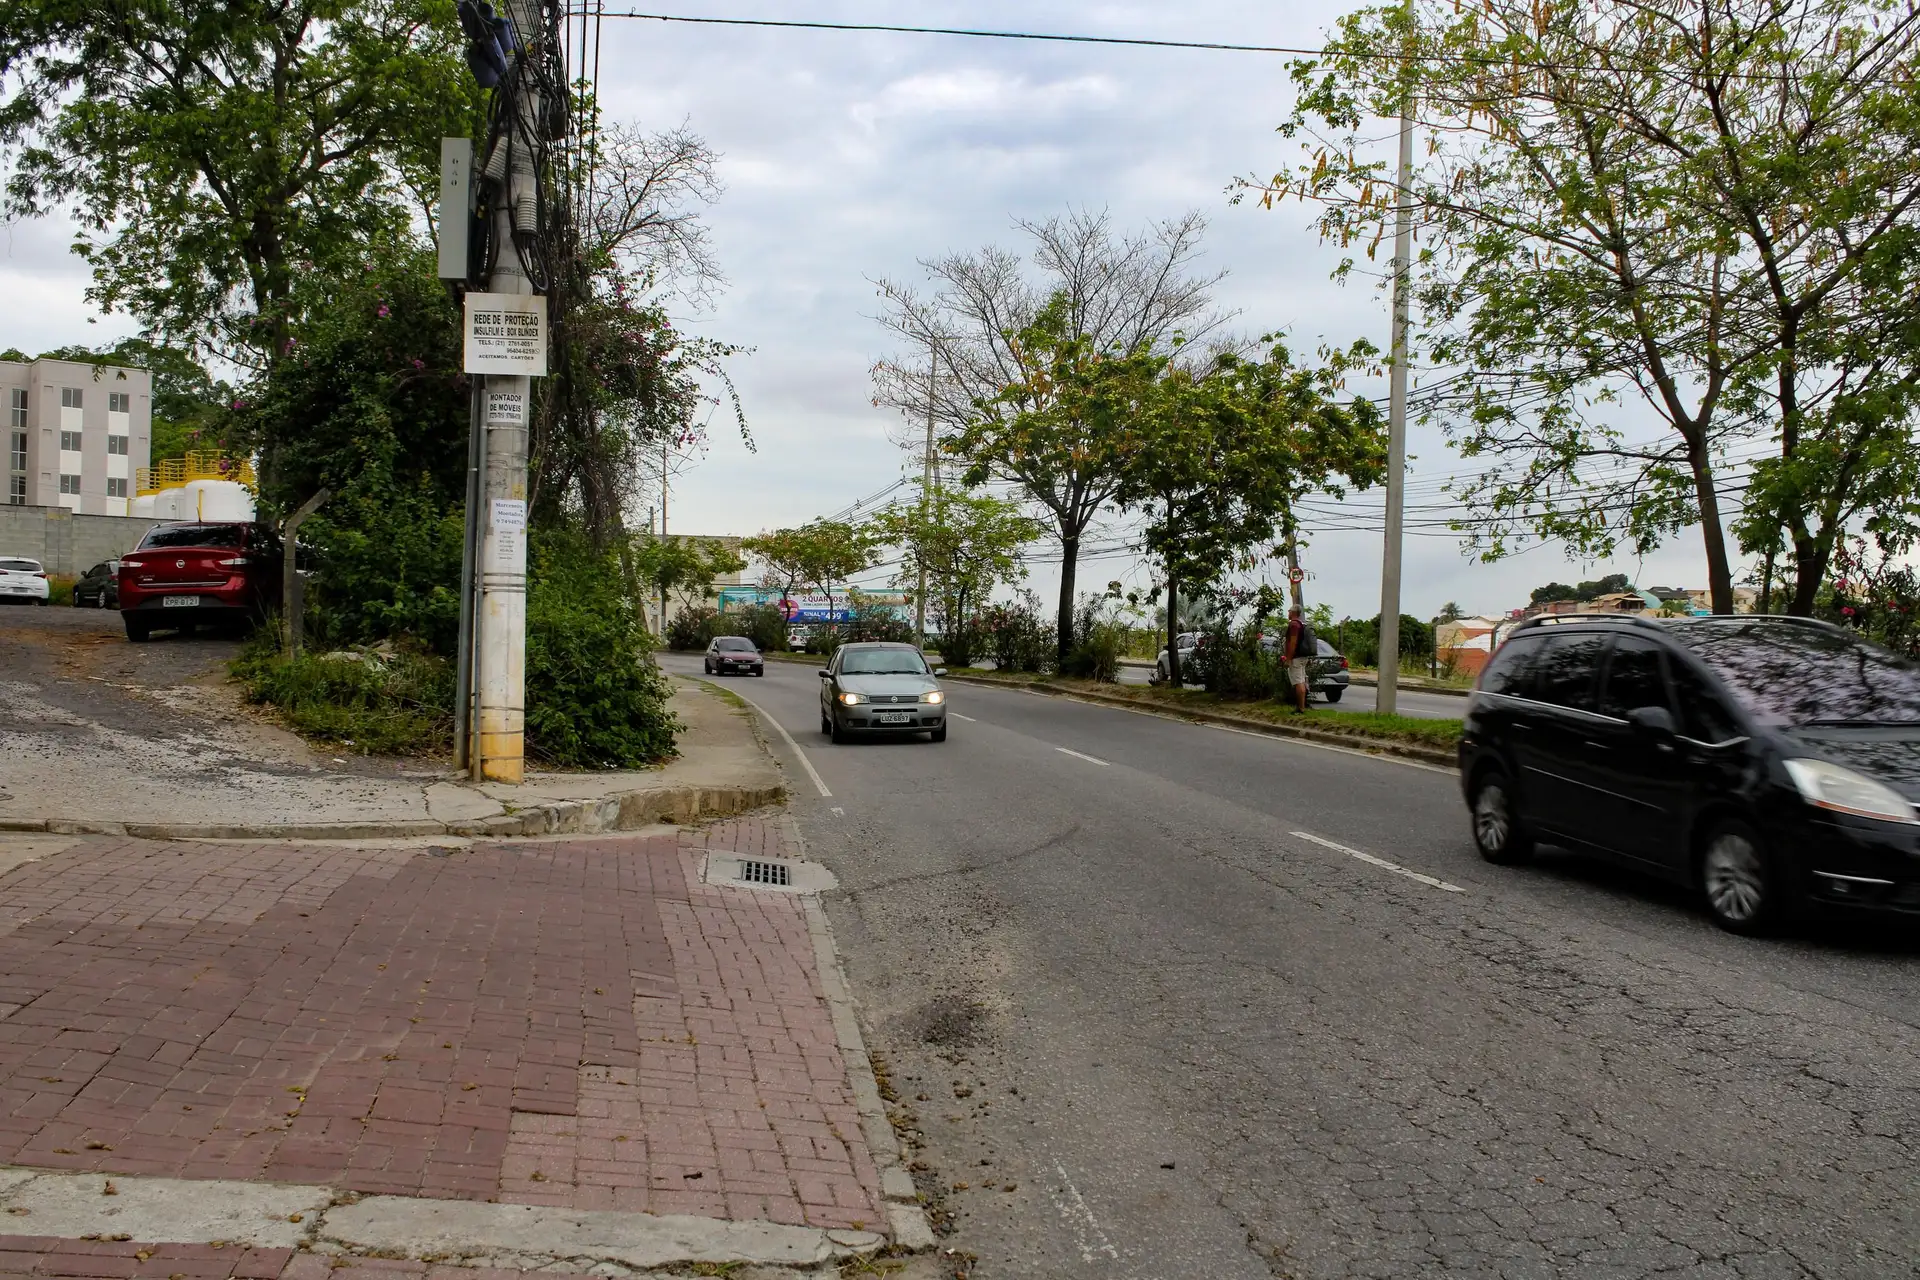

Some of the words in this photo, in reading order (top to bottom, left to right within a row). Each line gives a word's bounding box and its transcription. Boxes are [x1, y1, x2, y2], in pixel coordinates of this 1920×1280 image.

[474, 314, 491, 325] REDE
[492, 315, 501, 325] DE
[504, 313, 539, 328] PROTEÇÃO
[474, 326, 500, 336] INSULFILM
[501, 327, 504, 336] E
[507, 327, 517, 337] BOX
[518, 328, 539, 337] BLINDEX
[490, 393, 522, 402] MONTADOR
[490, 403, 498, 411] DE
